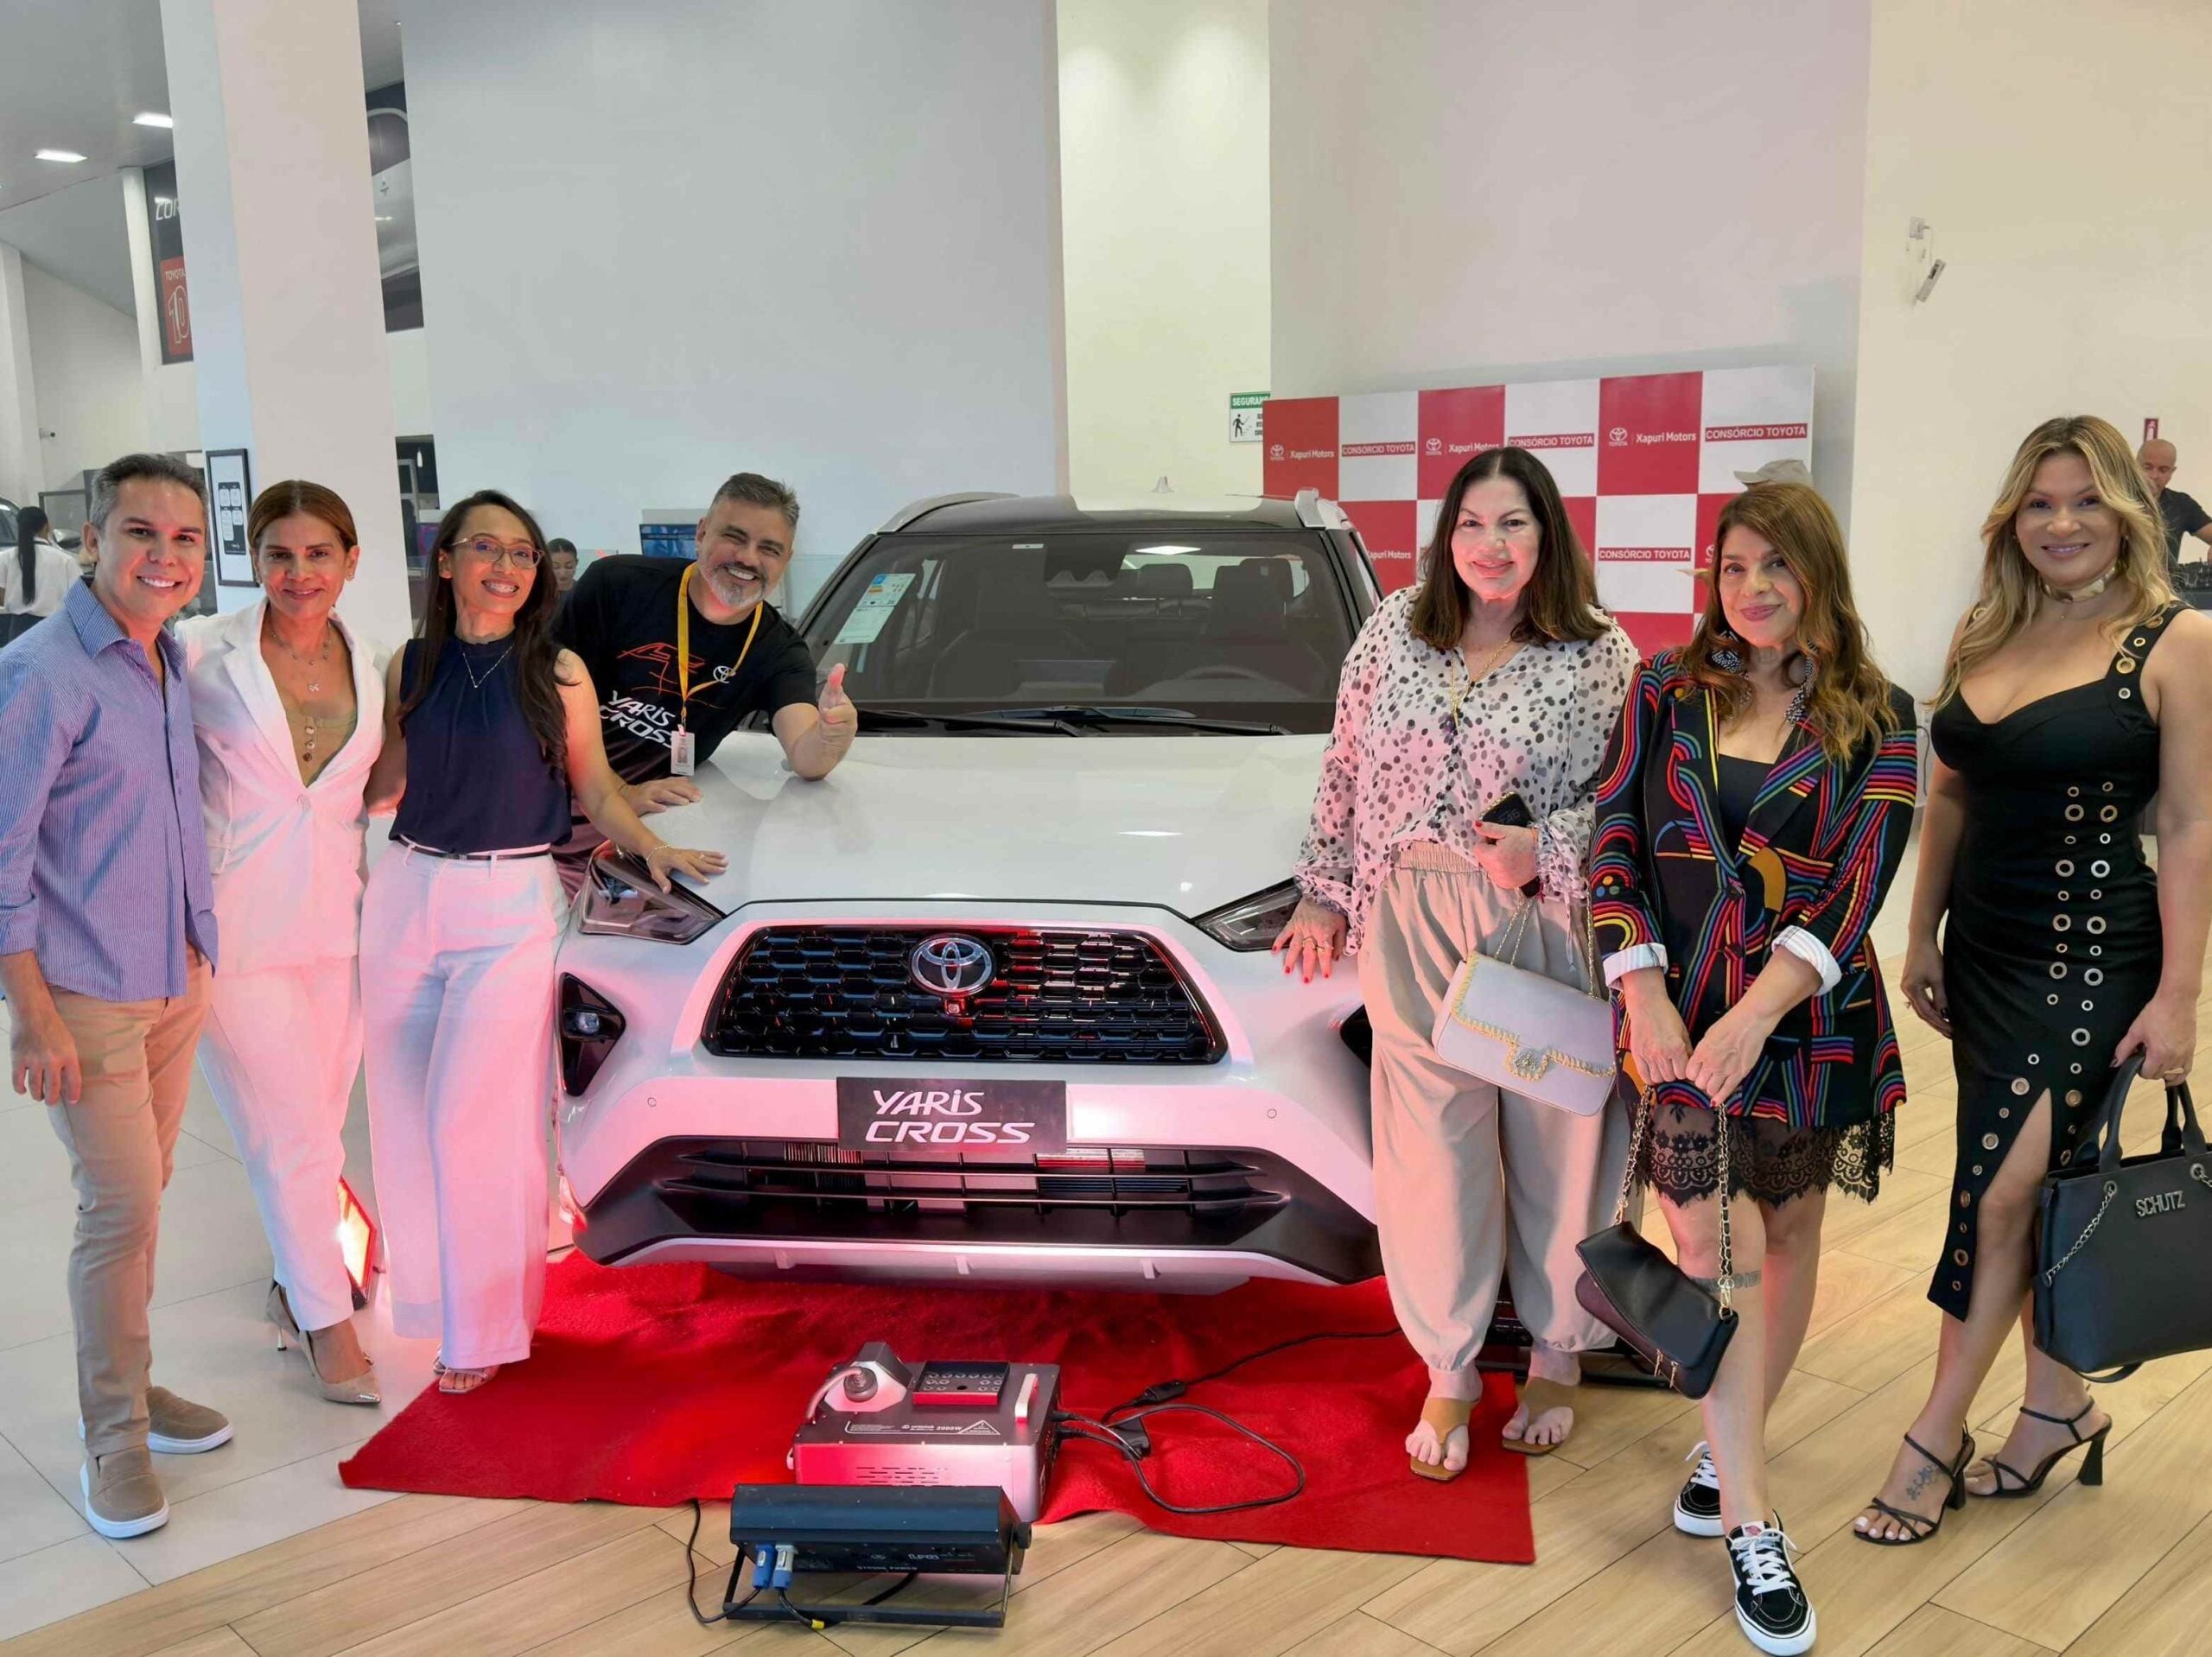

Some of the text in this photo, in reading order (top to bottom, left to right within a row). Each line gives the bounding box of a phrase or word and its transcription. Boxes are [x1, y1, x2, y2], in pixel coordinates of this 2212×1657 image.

[1636, 431, 1696, 445] Xapuri Motors
[1704, 425, 1807, 440] CONSÓRCIO TOYOTA
[1509, 435, 1593, 448] CONSÓRCIO TOYOTA
[1386, 443, 1414, 453] TOYOTA
[1448, 442, 1473, 454] Xapuri
[1290, 449, 1311, 461] Xapuri
[1312, 449, 1334, 458] Motors
[1387, 549, 1412, 560] Motors
[1599, 548, 1690, 560] CONSÓRCIO TOYOTA
[865, 1121, 1036, 1145] CROSS
[2135, 1190, 2186, 1217] SCHUTZ
